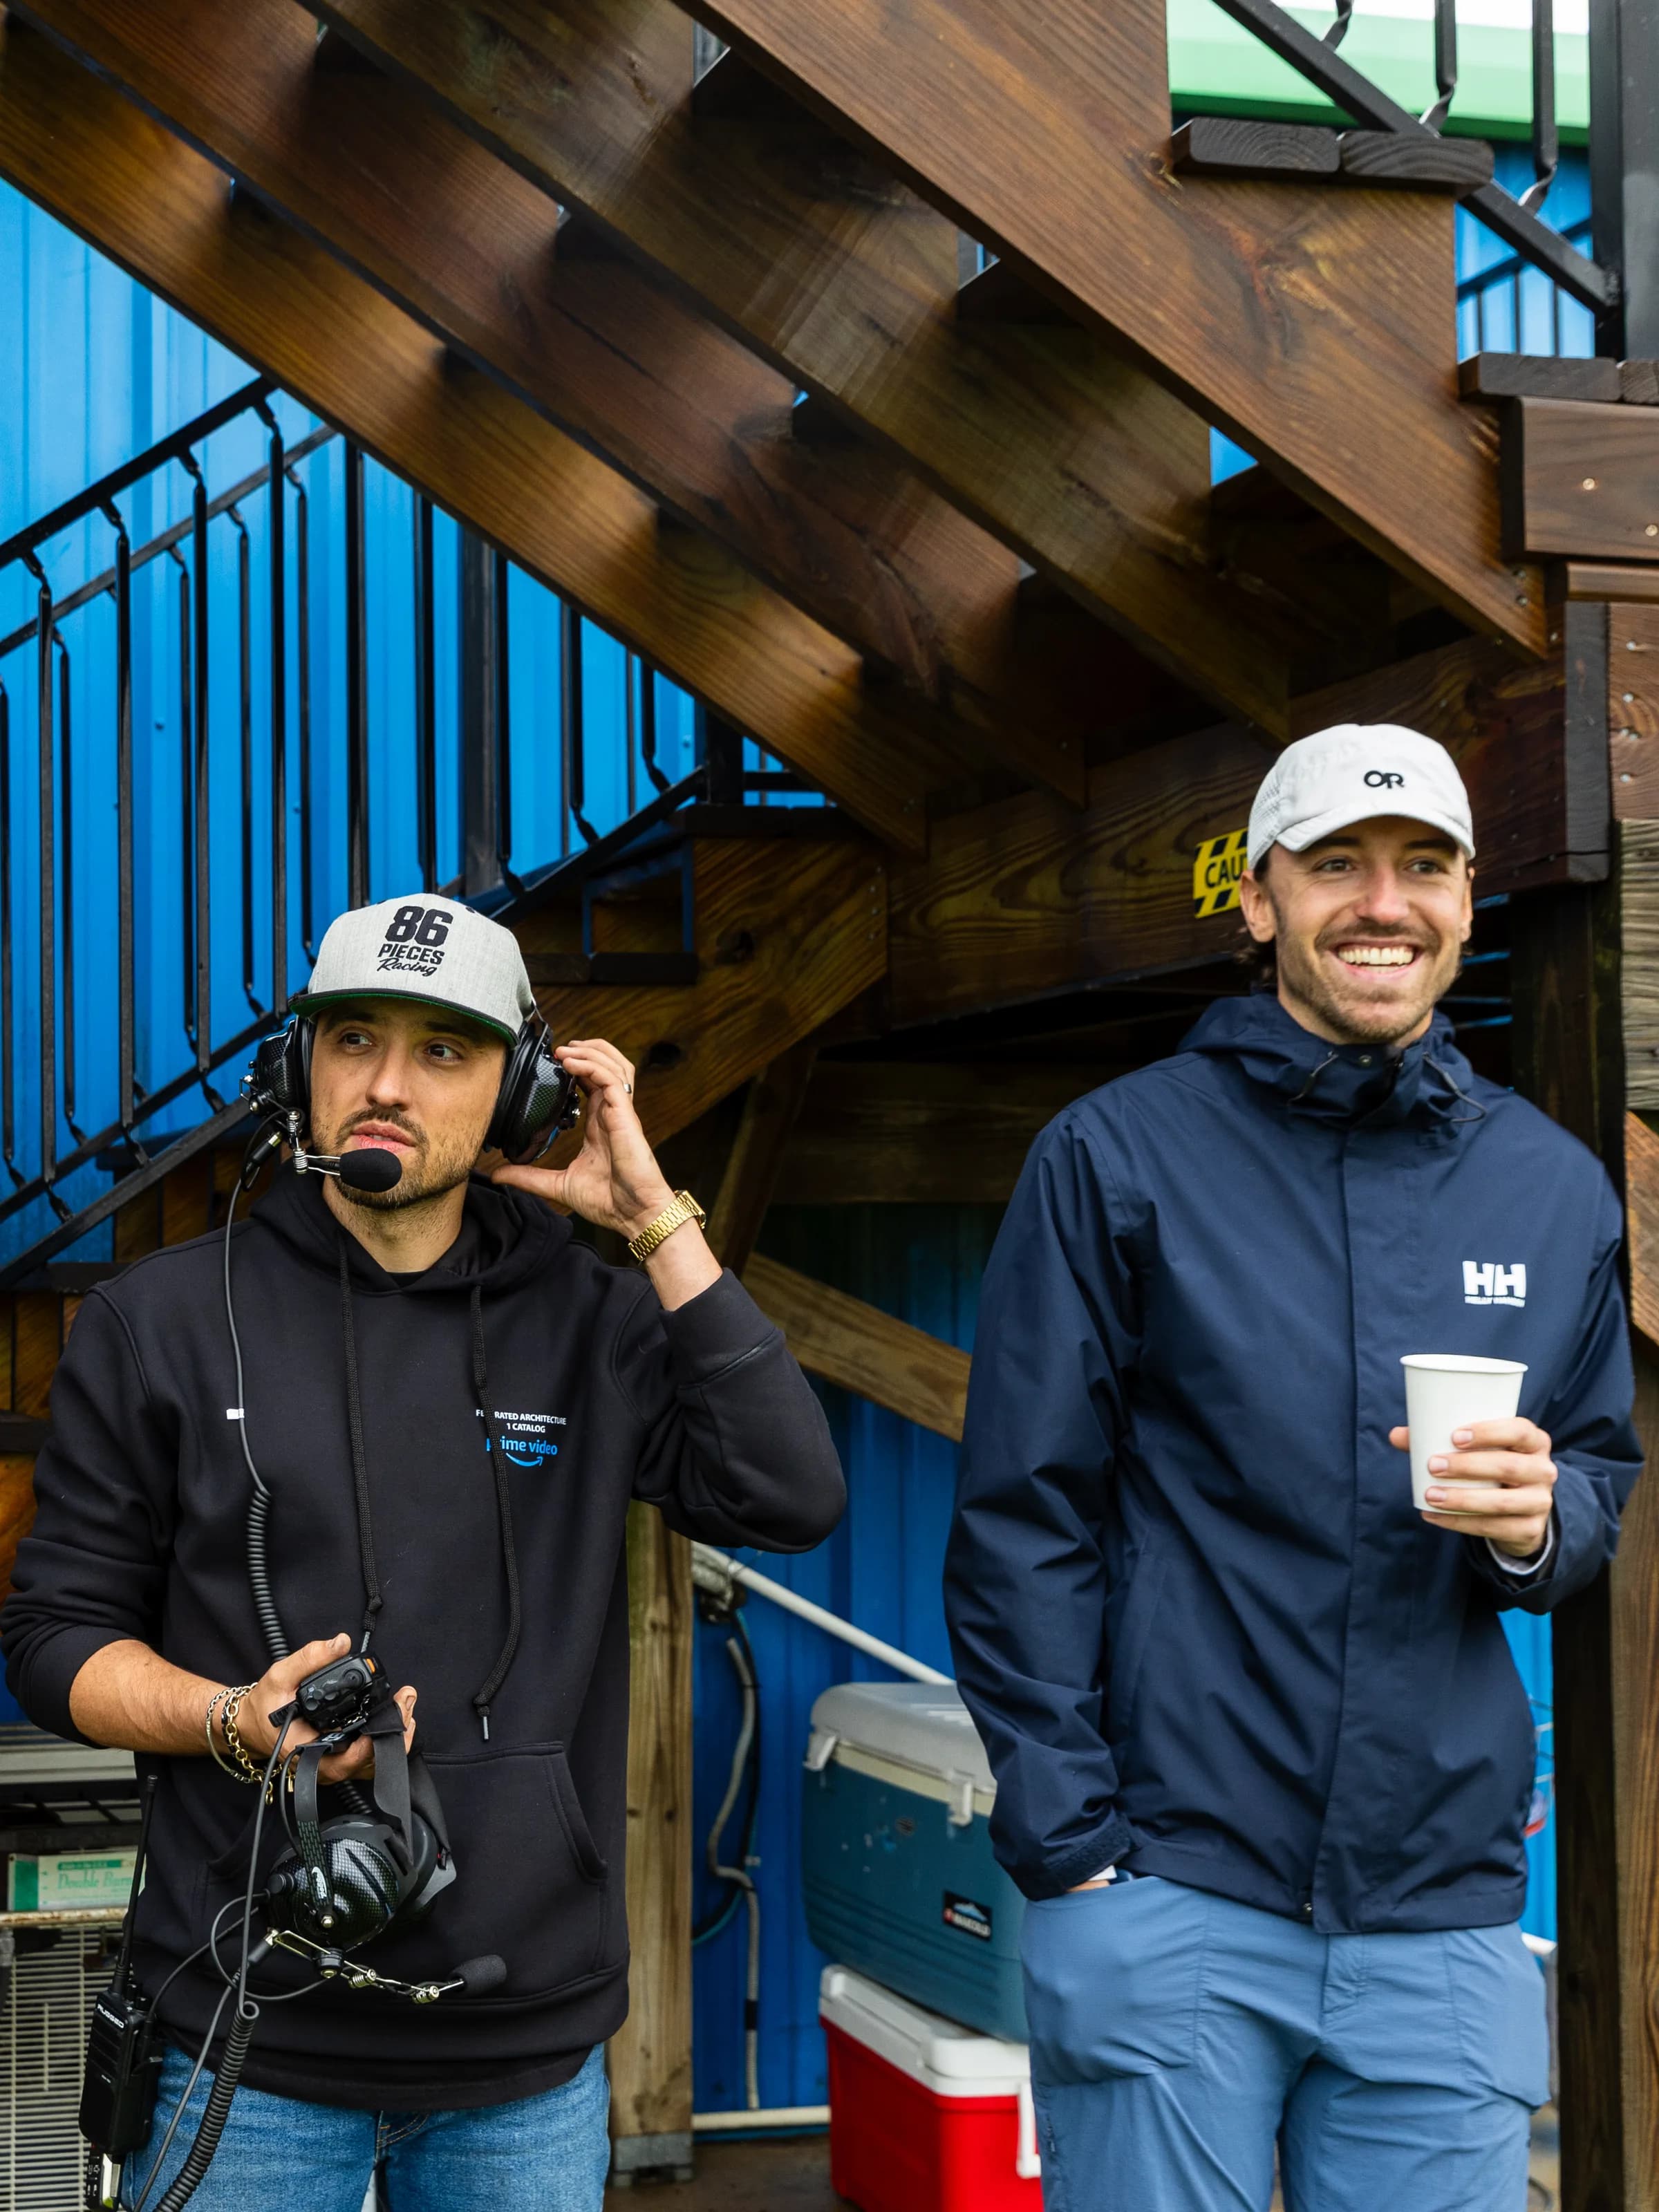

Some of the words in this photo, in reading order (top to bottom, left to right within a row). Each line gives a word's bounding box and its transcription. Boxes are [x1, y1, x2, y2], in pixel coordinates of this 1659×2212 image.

[1363, 770, 1405, 789] OR
[1205, 853, 1247, 888] CAU
[385, 906, 454, 947] 86
[377, 944, 445, 966] PIECES
[377, 957, 438, 977] Racing
[1462, 1260, 1527, 1300] HH
[476, 1409, 518, 1421] FERATED
[519, 1414, 567, 1425] ARCHITECTURE
[512, 1423, 545, 1433] CATALOG
[528, 1439, 558, 1455] video
[104, 1871, 133, 1887] Burn
[97, 2003, 124, 2029] RUGGED
